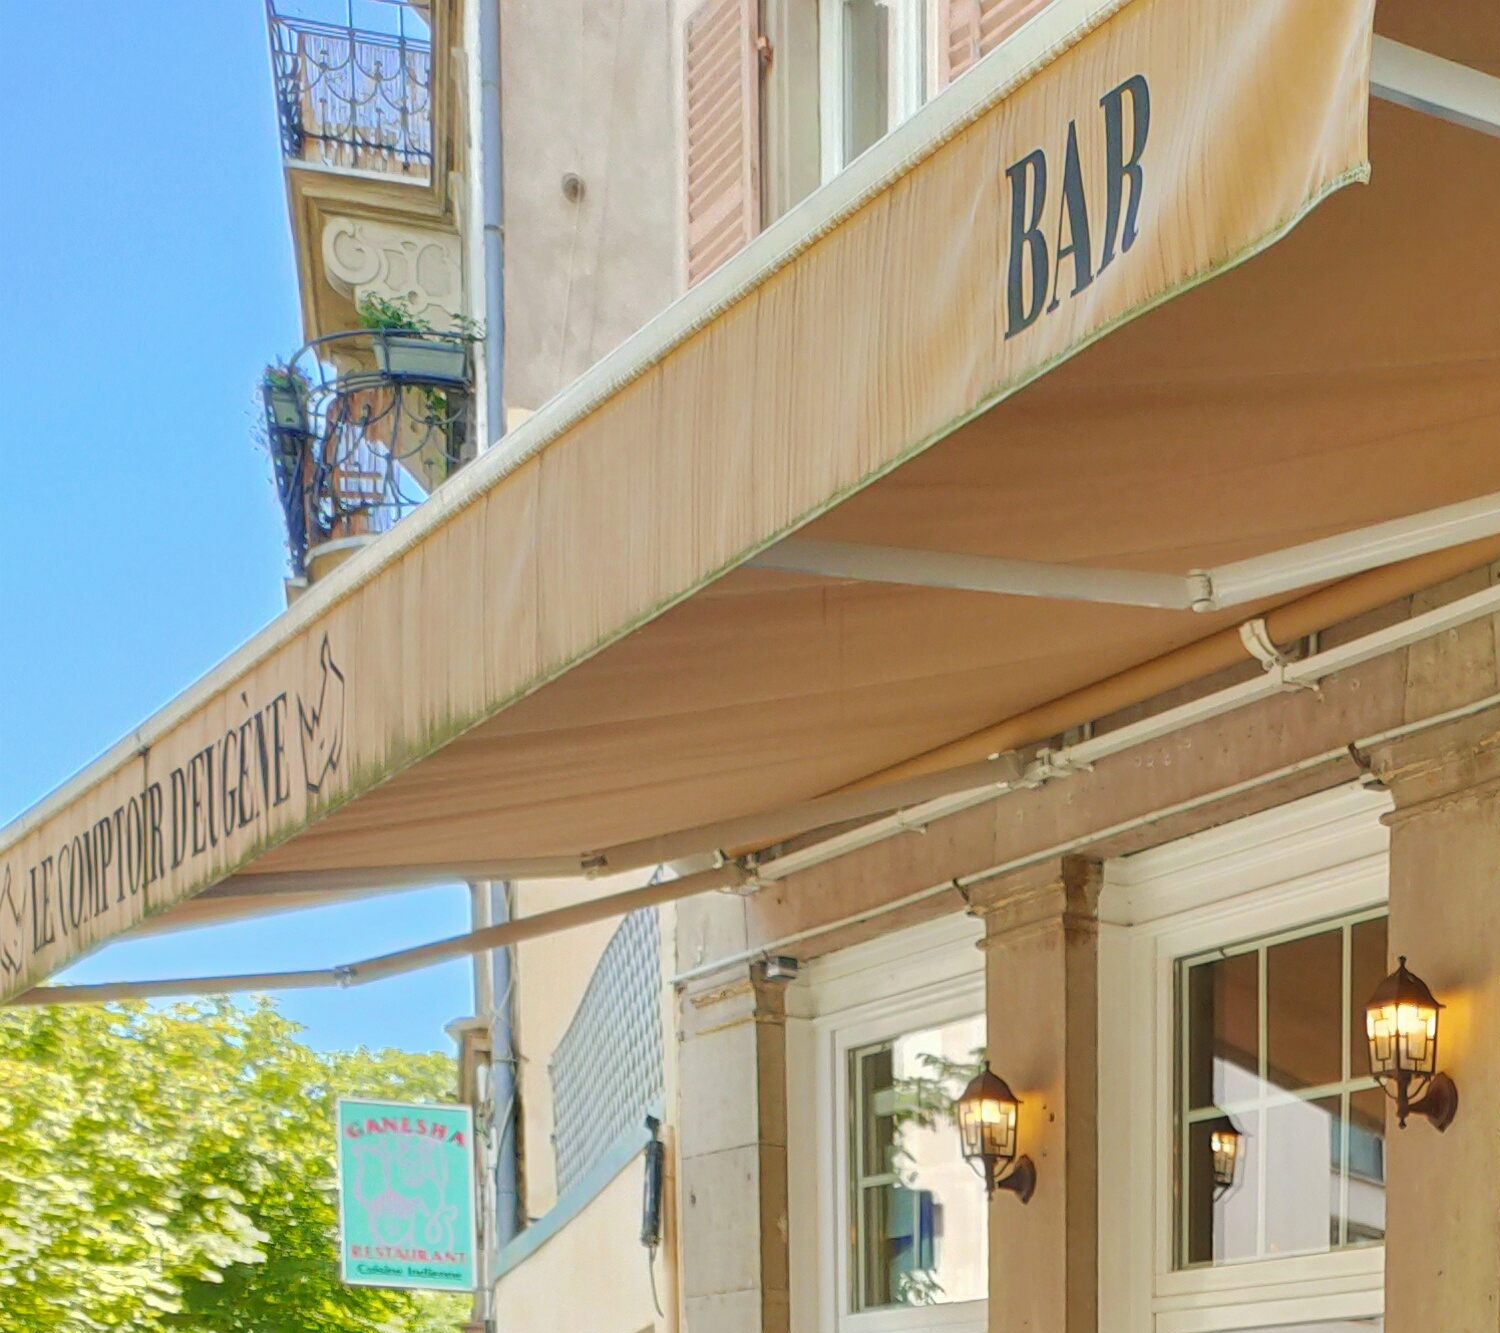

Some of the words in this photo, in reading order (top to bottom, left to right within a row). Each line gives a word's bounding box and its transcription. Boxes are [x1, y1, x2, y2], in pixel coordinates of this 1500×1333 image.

[1004, 73, 1151, 341] BAR
[29, 854, 57, 955] LE
[57, 781, 165, 937] COMPTOIR
[169, 691, 291, 871] D'EUGÈNE
[344, 1117, 466, 1147] GANESHA
